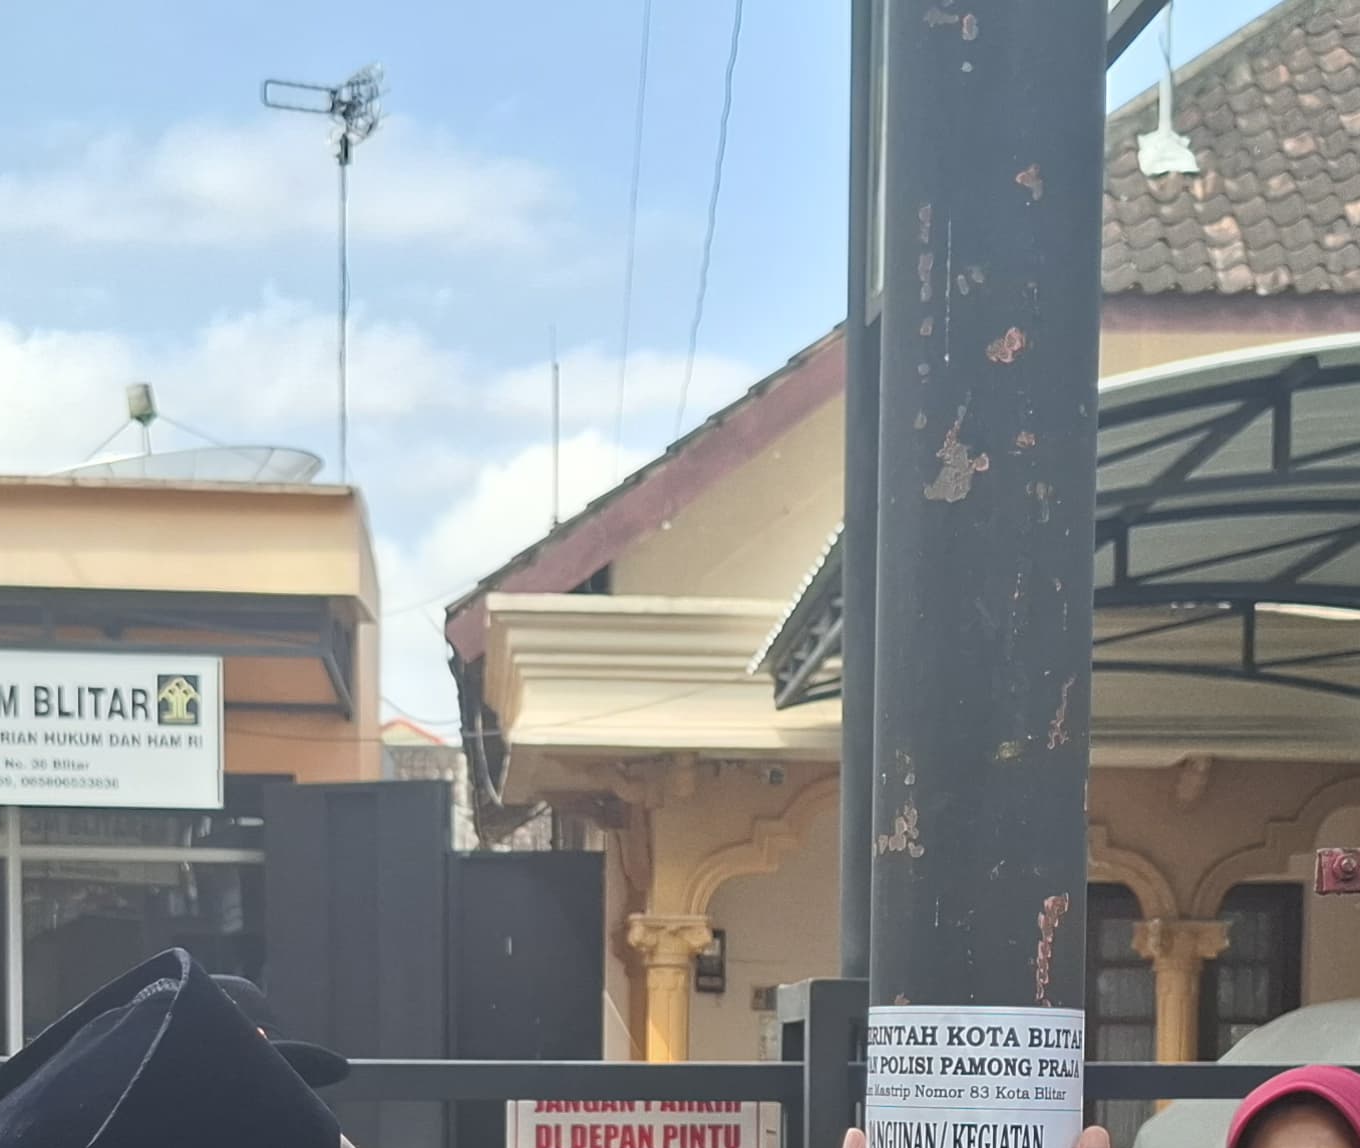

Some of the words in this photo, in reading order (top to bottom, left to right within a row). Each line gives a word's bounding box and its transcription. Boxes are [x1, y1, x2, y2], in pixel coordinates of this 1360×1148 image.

[33, 685, 150, 720] BLITAR
[44, 732, 103, 746] HUKUM
[109, 734, 141, 747] DAN
[147, 734, 182, 748] HAM
[188, 735, 203, 748] RI
[946, 1026, 1021, 1047] KOTA
[880, 1056, 934, 1075] POLISI
[940, 1057, 1032, 1077] PAMONG
[1038, 1058, 1080, 1079] PRAJA
[915, 1085, 966, 1099] Nomor
[970, 1085, 990, 1099] 83
[995, 1086, 1031, 1100] Kota
[1035, 1087, 1067, 1101] Blitar
